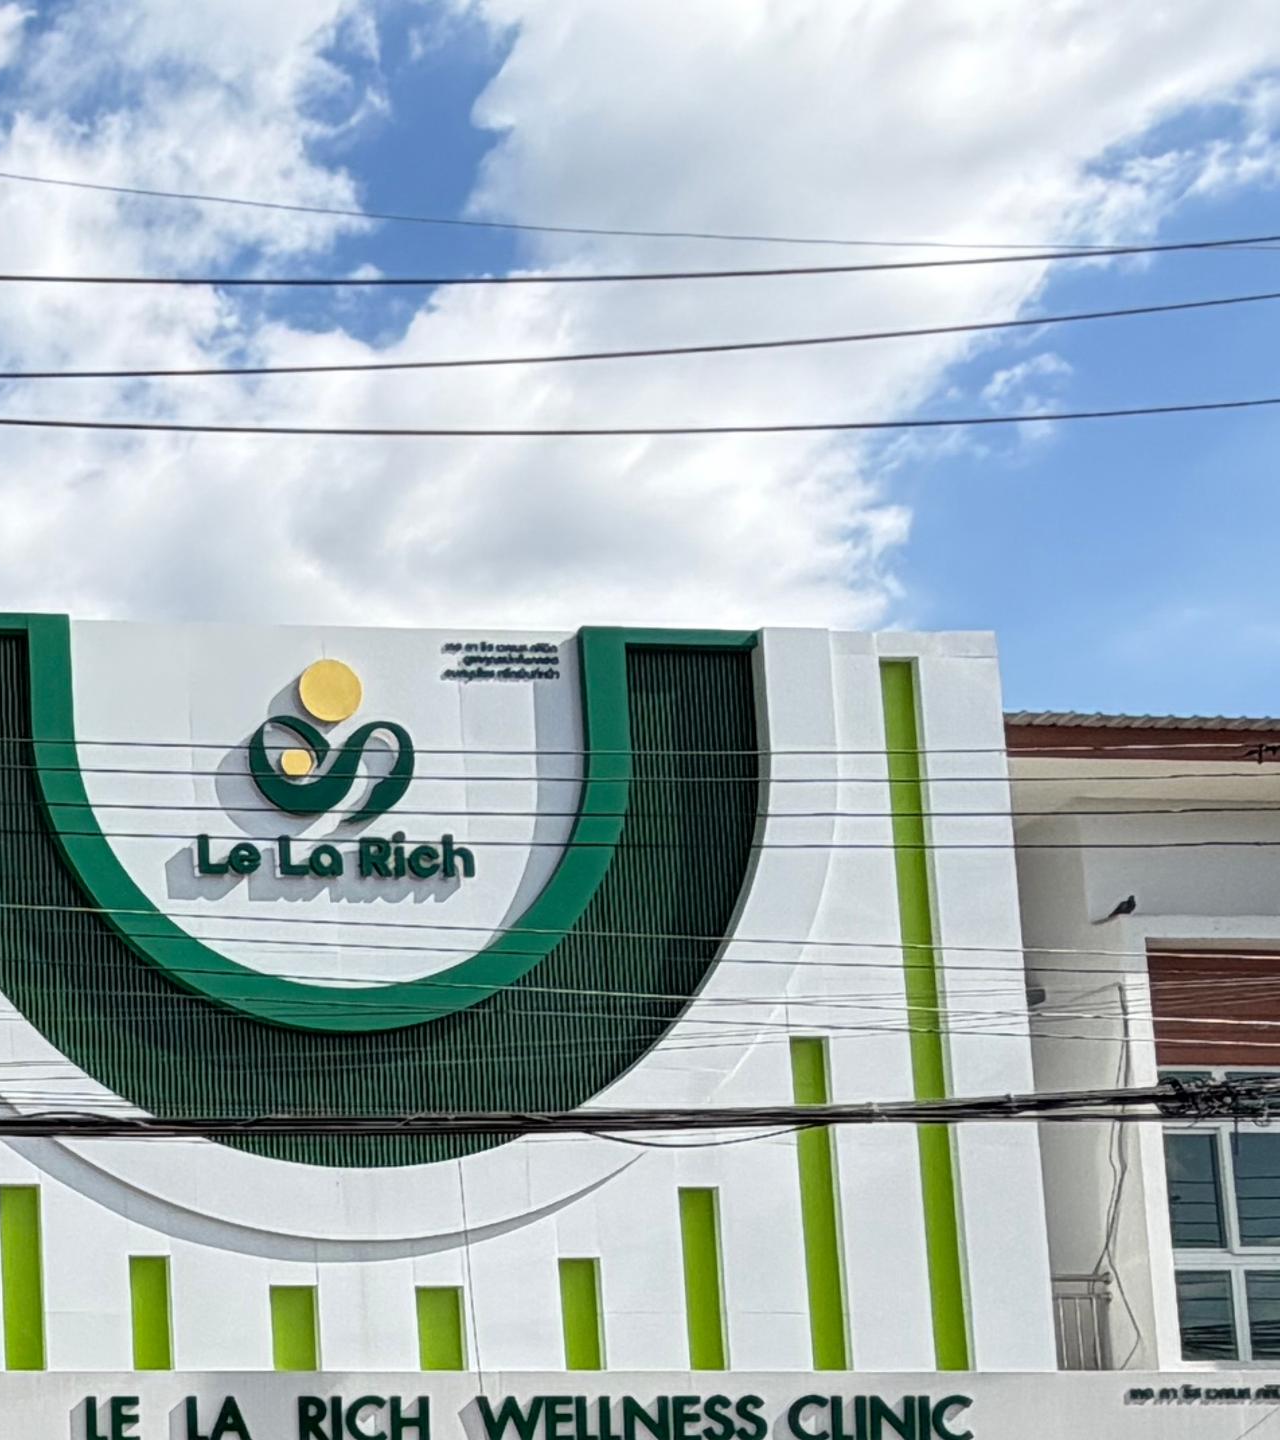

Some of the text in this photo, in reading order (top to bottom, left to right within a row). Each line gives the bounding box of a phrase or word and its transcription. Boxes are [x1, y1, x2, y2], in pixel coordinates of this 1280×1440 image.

[196, 830, 476, 879] Le La Rich
